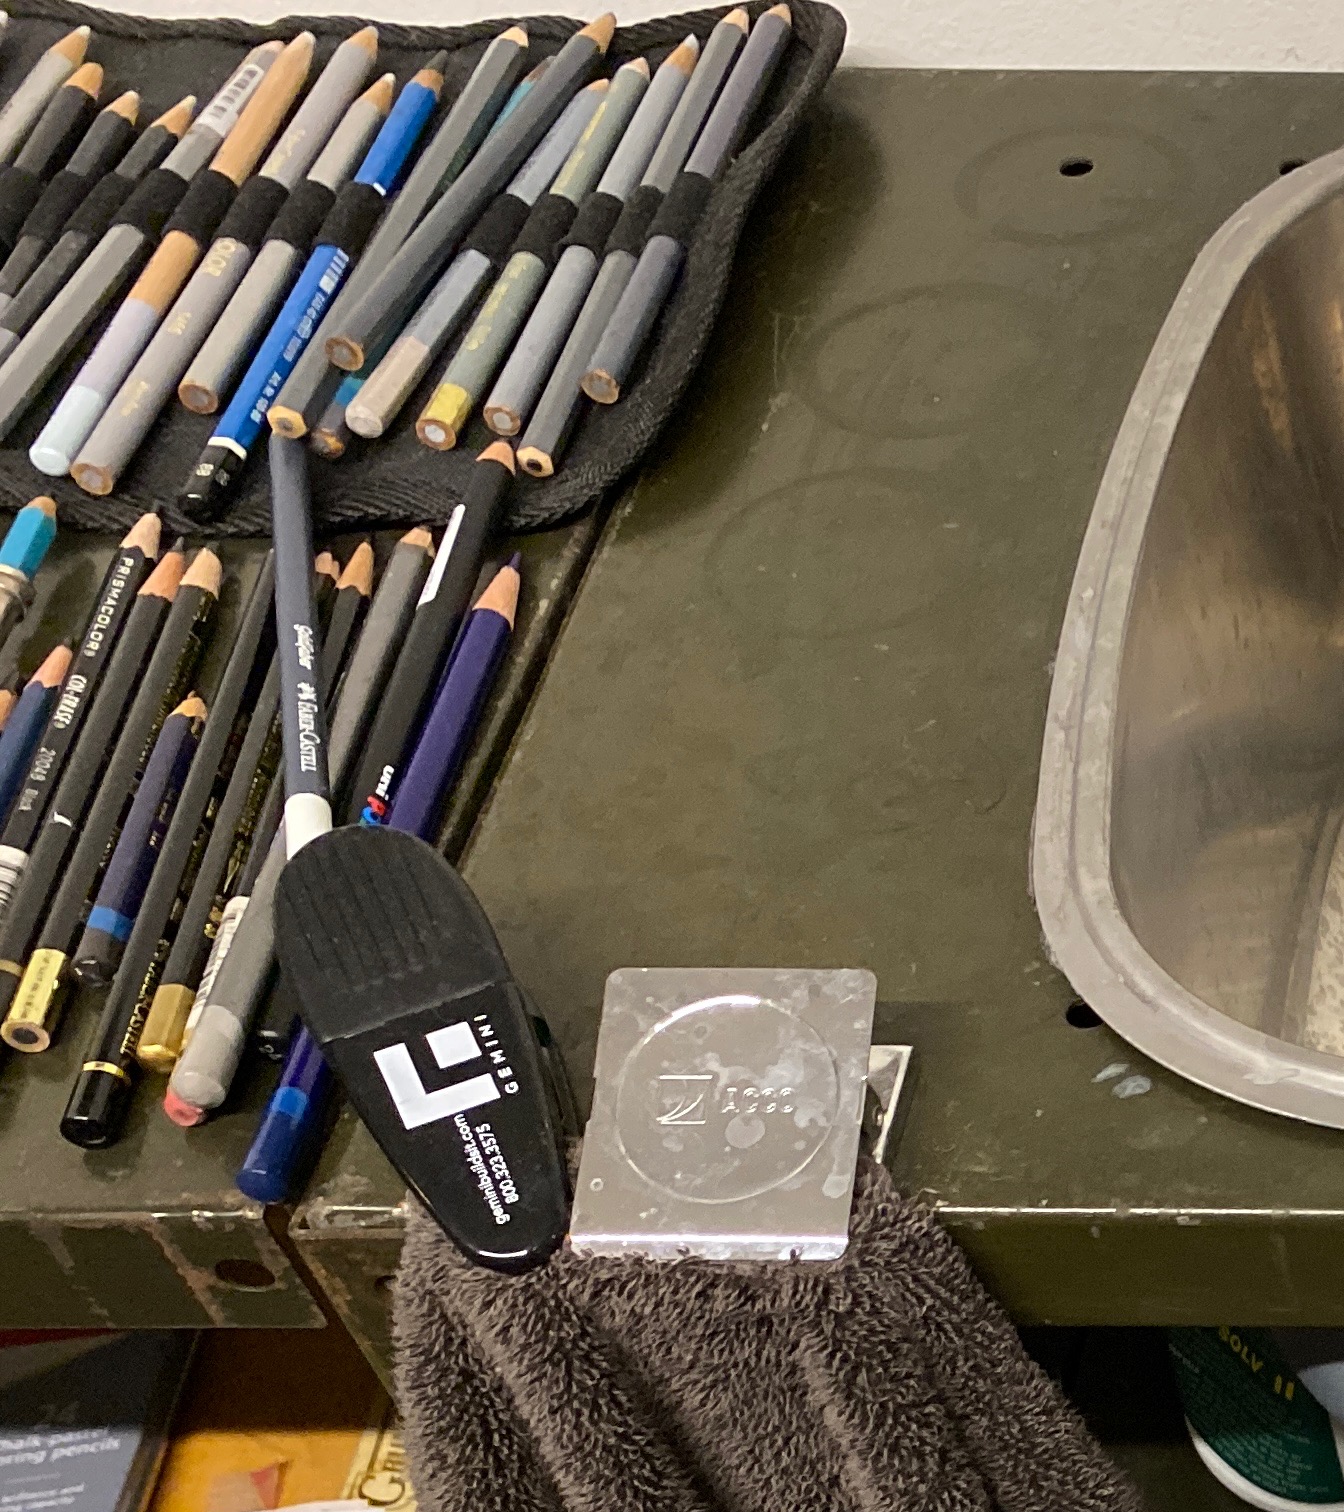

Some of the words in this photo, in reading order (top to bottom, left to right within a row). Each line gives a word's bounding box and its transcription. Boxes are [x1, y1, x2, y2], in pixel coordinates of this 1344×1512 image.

[375, 764, 395, 801] uni
[474, 1014, 519, 1094] GEMINI
[453, 1113, 511, 1225] geminibuildsit.com
[475, 1123, 519, 1204] 800.323.3575
